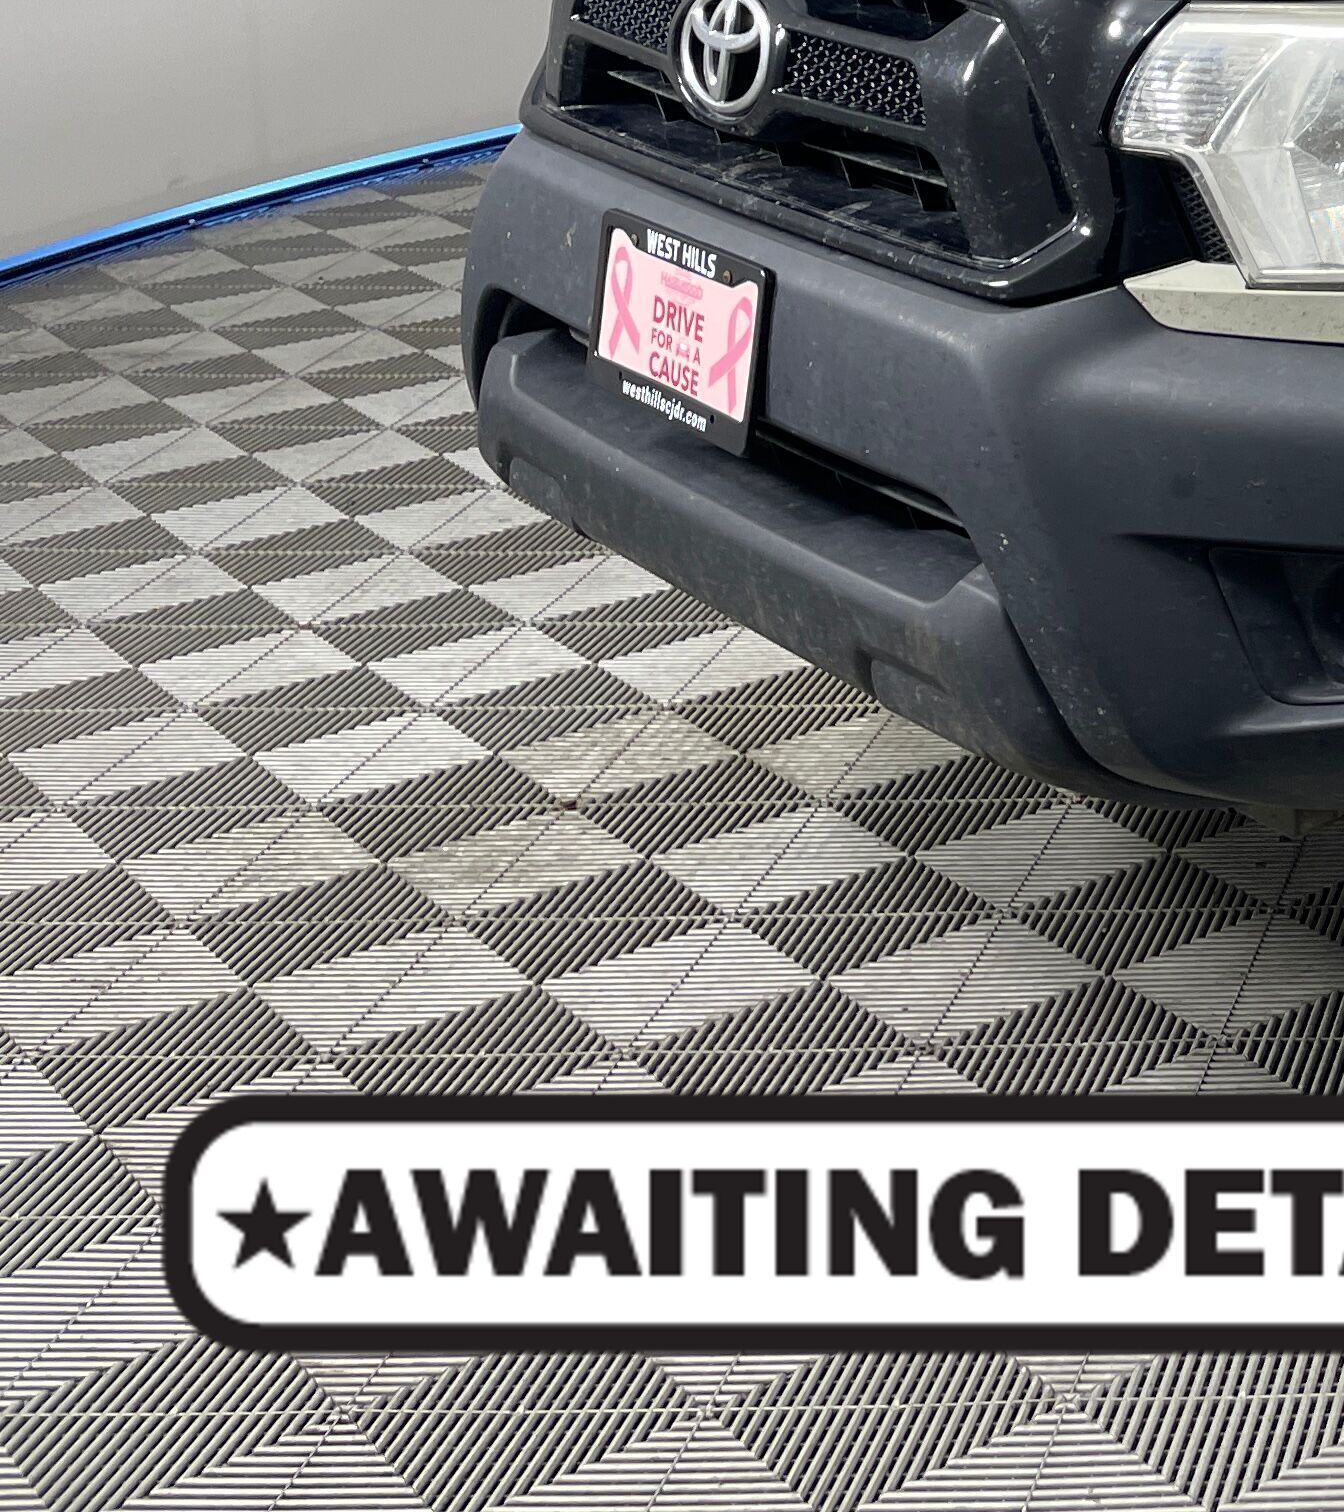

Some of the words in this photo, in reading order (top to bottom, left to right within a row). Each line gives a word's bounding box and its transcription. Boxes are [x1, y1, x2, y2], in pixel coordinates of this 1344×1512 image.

[646, 229, 681, 262] WEST
[682, 244, 717, 279] HILLS
[652, 295, 705, 343] DRIVE
[651, 328, 673, 351] FOR
[692, 346, 701, 366] A
[649, 351, 699, 397] CAUSE
[622, 379, 707, 432] westhillscjdr.com
